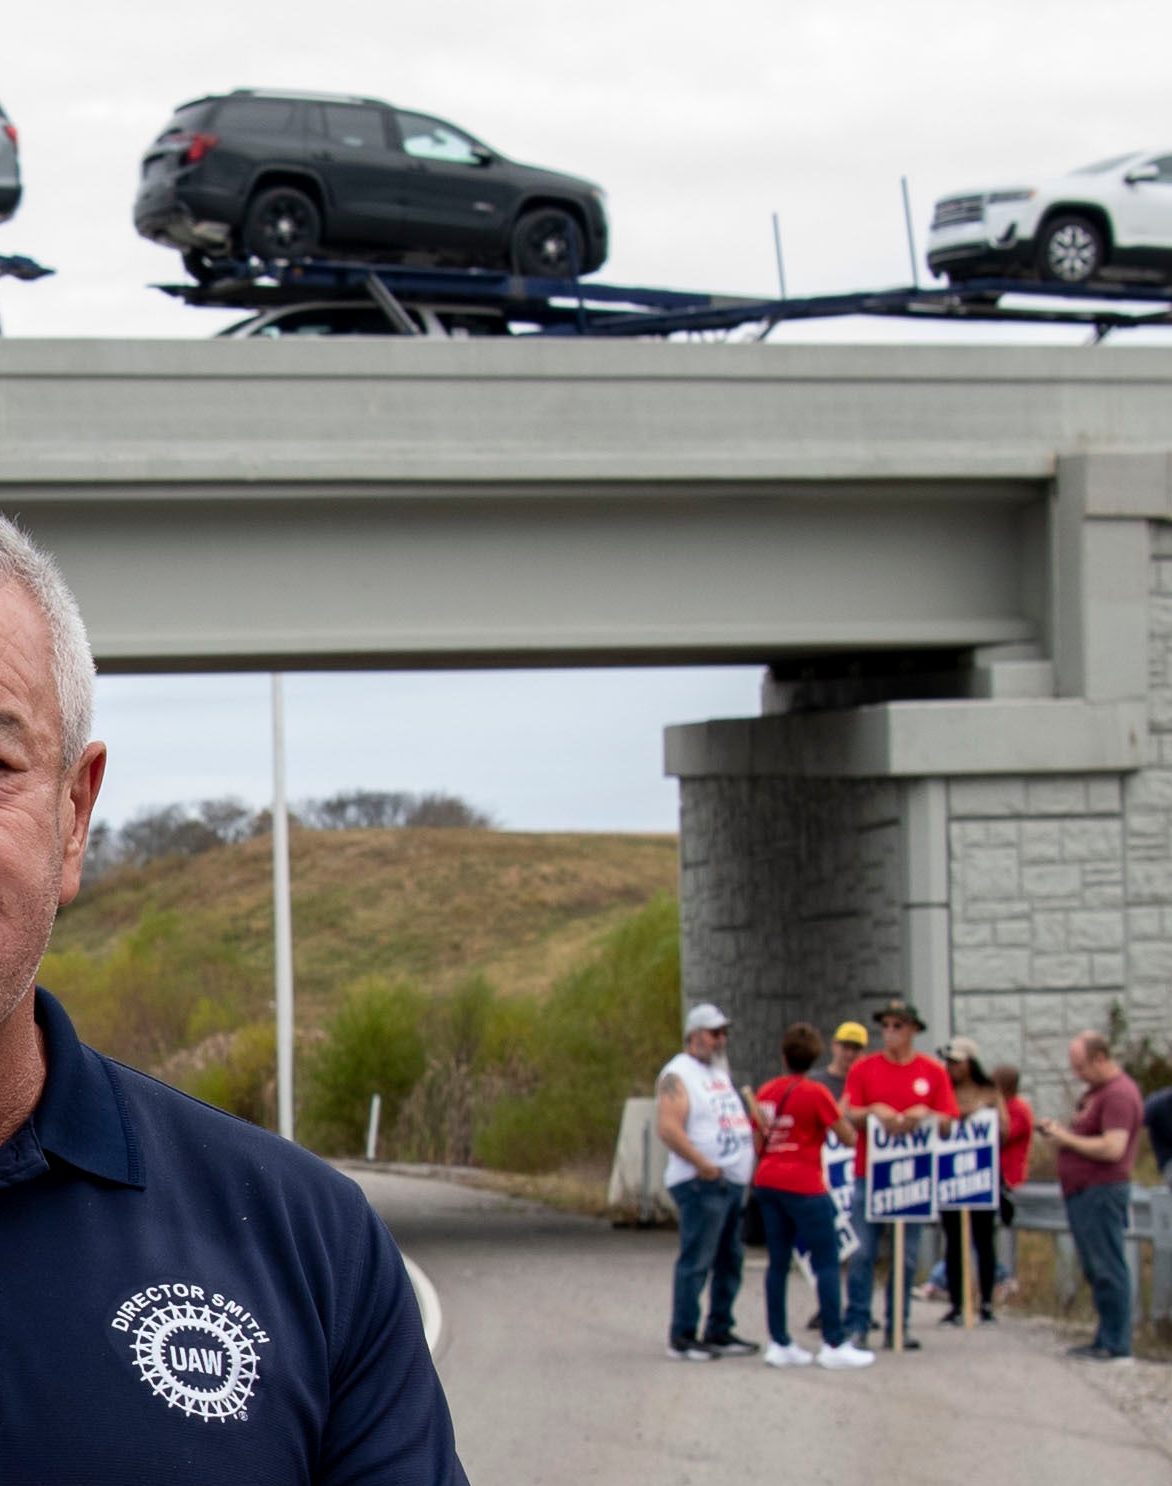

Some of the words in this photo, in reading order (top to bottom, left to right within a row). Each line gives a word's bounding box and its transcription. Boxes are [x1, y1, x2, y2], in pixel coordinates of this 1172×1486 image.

[111, 1283, 206, 1333] DIRECTOR
[211, 1293, 271, 1345] SMITH
[169, 1345, 224, 1377] UAW
